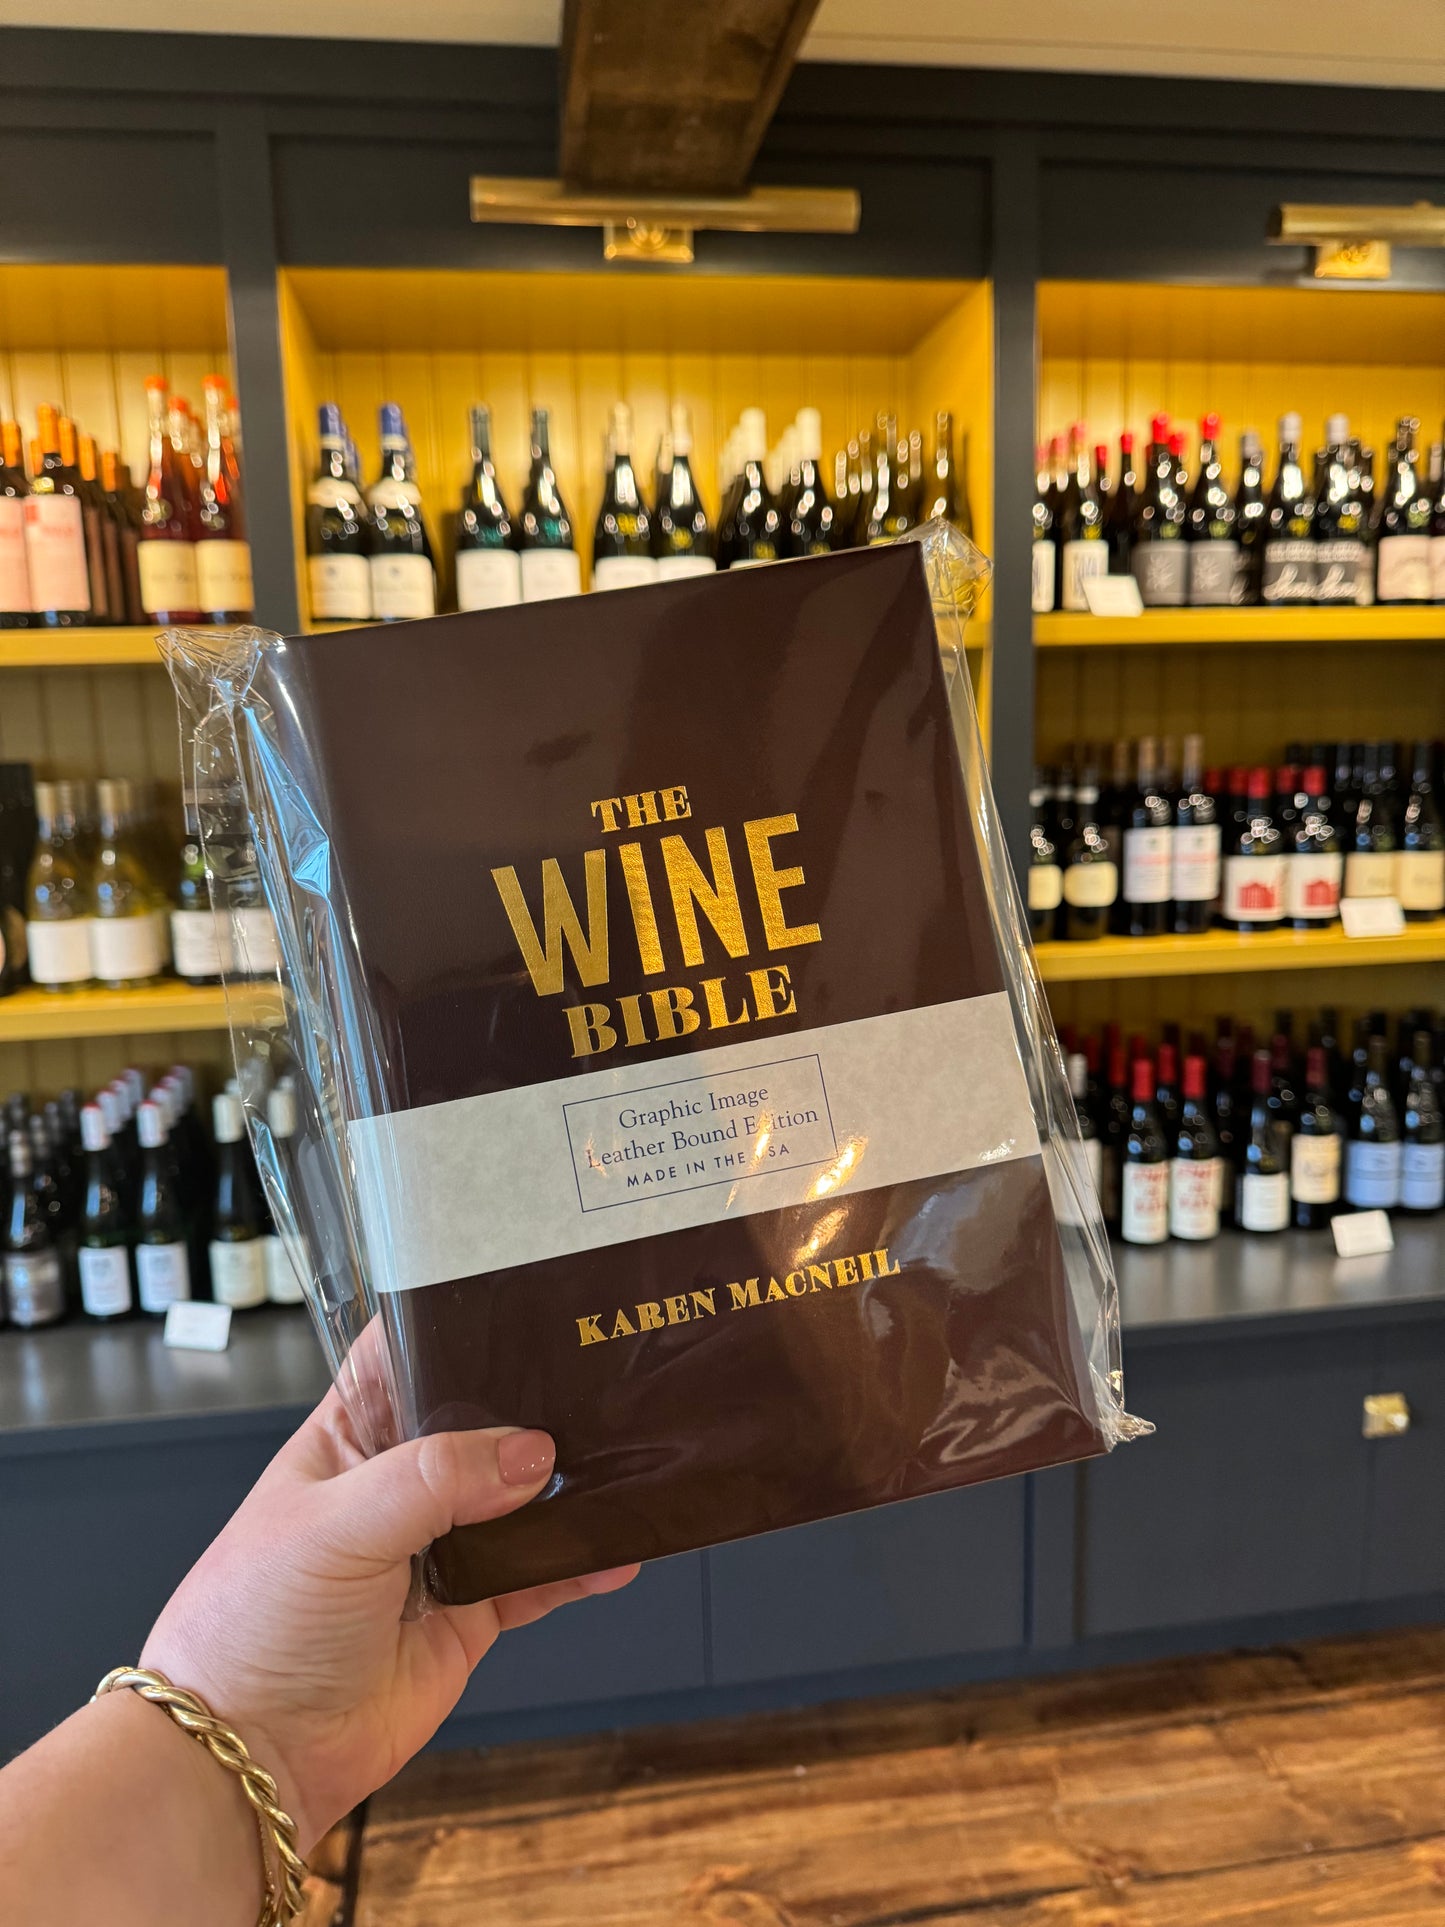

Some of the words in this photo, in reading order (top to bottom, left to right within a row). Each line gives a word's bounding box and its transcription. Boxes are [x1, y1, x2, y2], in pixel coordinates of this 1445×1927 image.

[590, 784, 692, 833] THE
[490, 813, 822, 997] WINE
[562, 965, 798, 1059] BIBLE
[618, 1099, 704, 1129] Graphic
[708, 1087, 770, 1112] Image
[587, 1139, 665, 1169] Leather
[672, 1119, 739, 1150] Bound
[745, 1109, 819, 1137] Eition
[627, 1166, 678, 1188] MADE
[686, 1160, 706, 1175] IN
[714, 1151, 746, 1170] THE
[753, 1144, 791, 1163] SA
[575, 1287, 717, 1347] KAREN
[726, 1248, 902, 1311] MACNEIL
